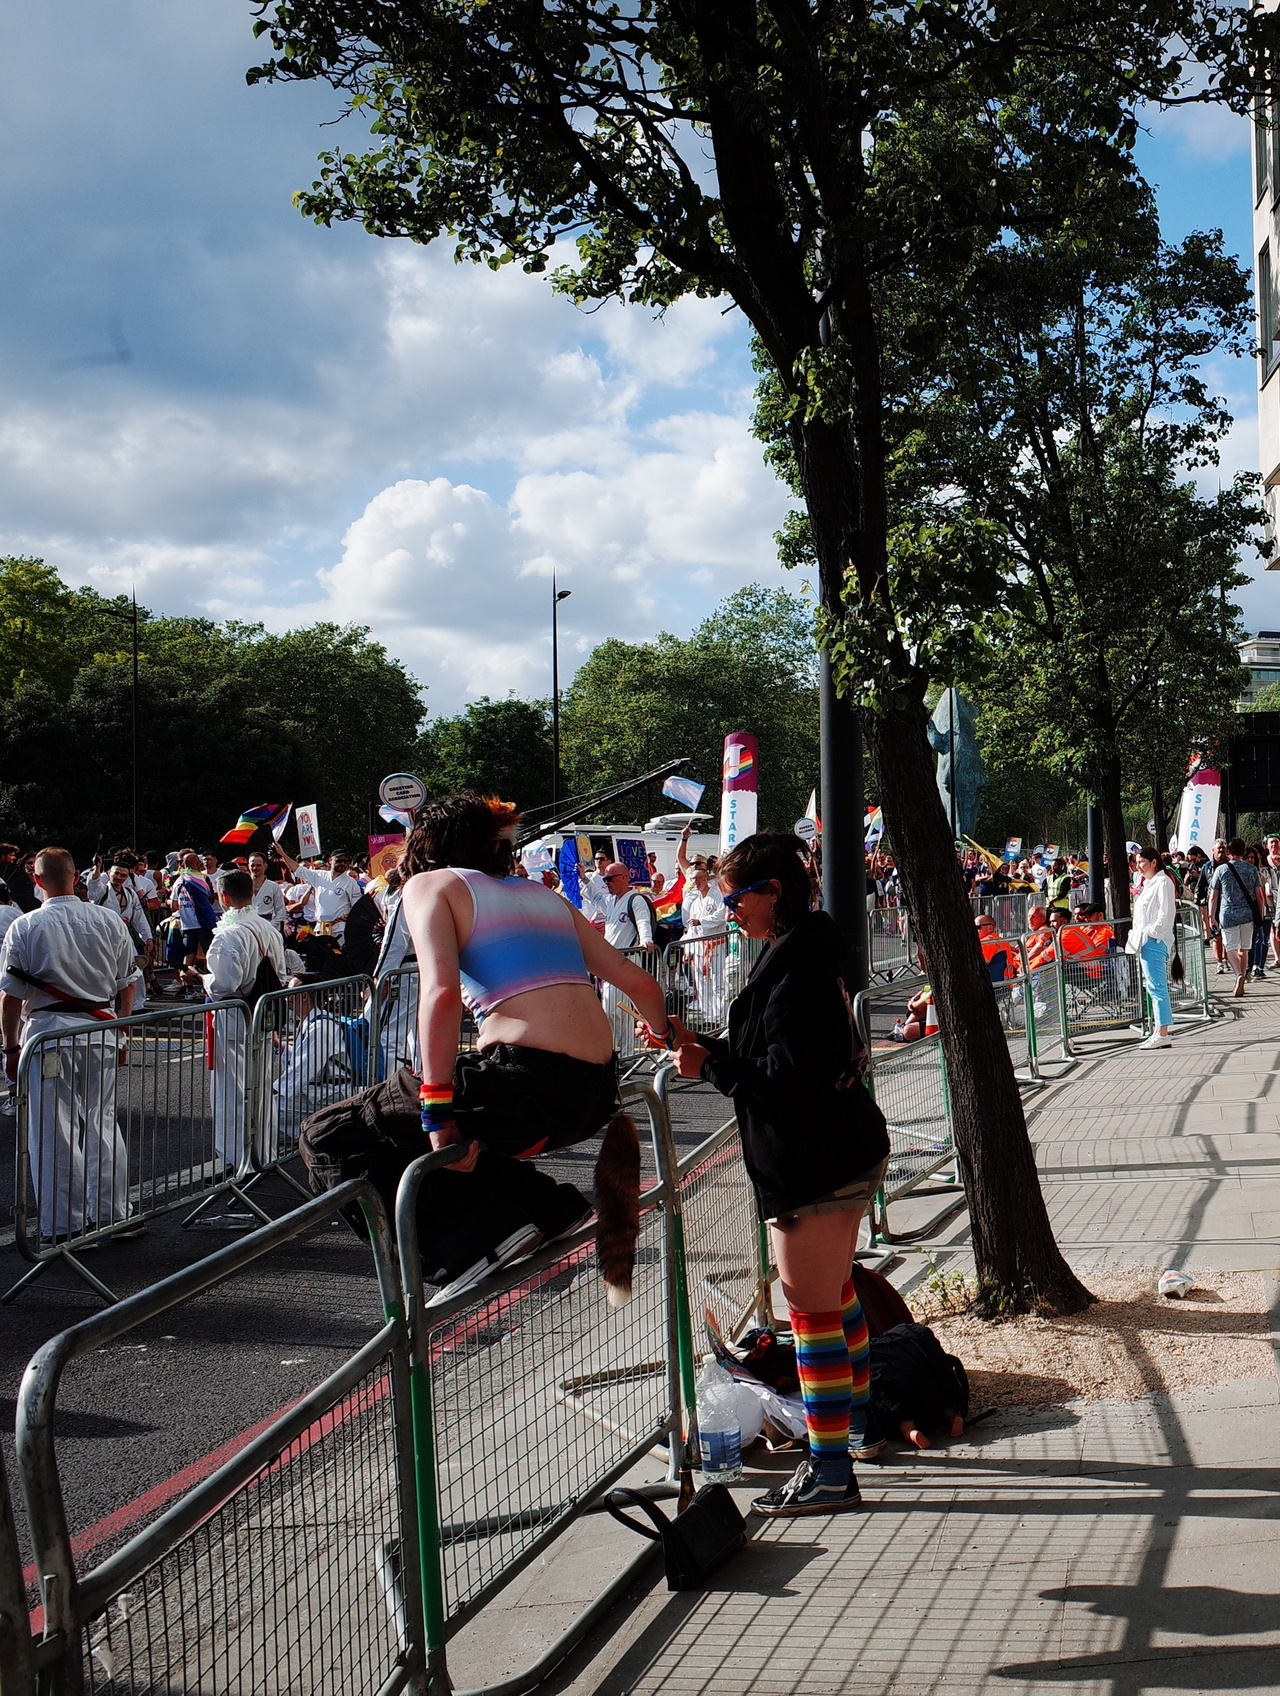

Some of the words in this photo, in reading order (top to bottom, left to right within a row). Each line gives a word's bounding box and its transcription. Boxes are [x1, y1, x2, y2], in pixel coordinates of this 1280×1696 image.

[388, 793, 421, 801] ASSOCIATION
[300, 812, 313, 824] YOU
[1189, 793, 1203, 846] STAR
[301, 823, 314, 836] ARE
[620, 845, 643, 858] LOVE
[628, 867, 648, 880] OVE
